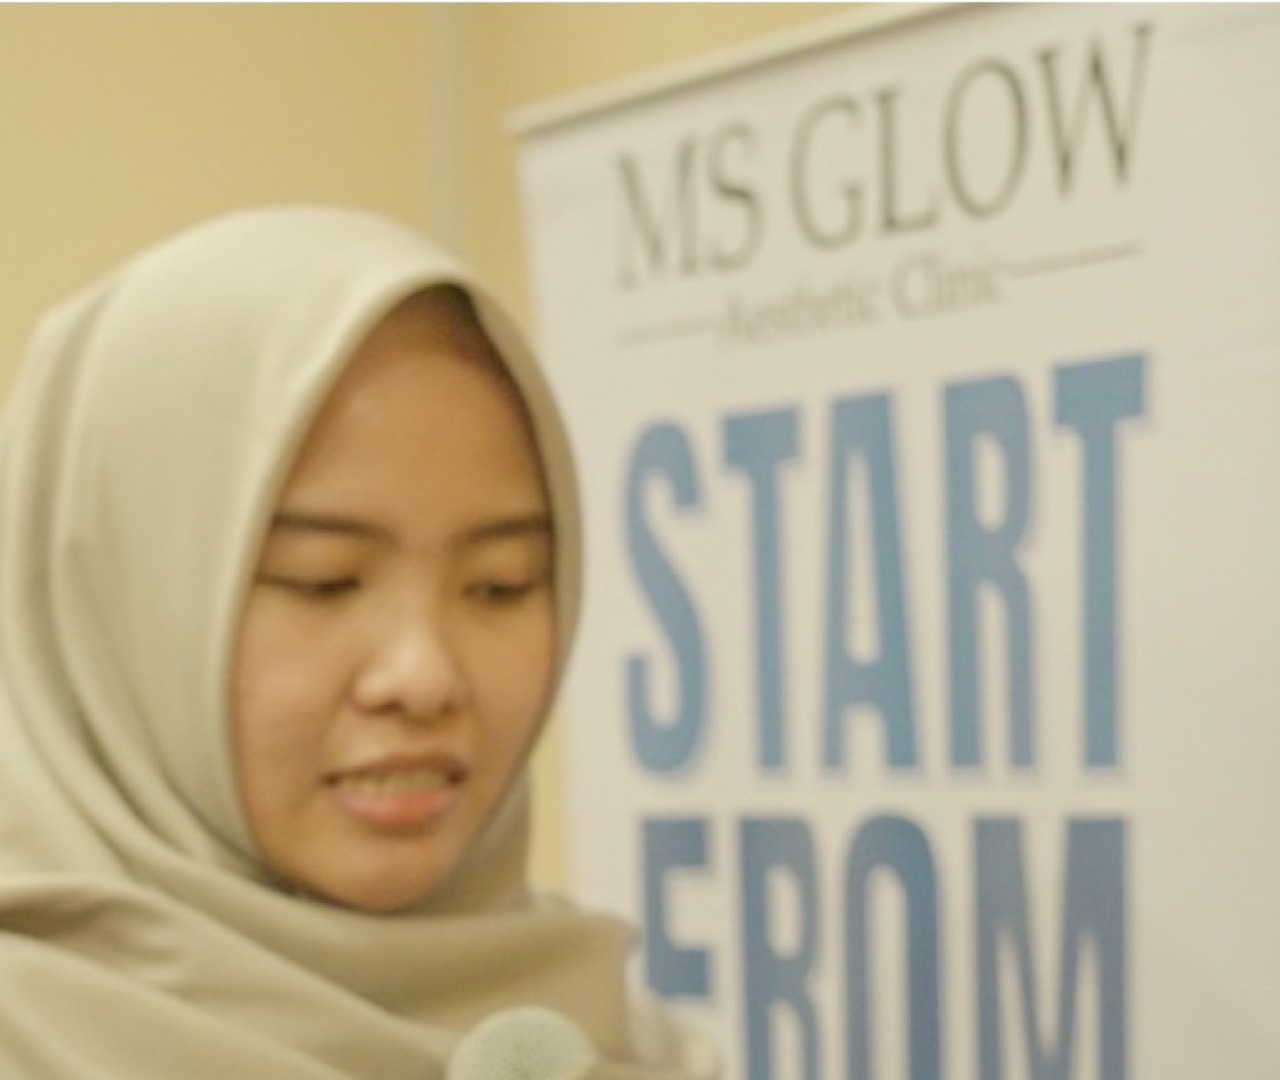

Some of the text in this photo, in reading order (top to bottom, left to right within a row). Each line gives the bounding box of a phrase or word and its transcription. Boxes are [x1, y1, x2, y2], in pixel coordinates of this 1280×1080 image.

[613, 21, 1154, 293] MS GLOW
[888, 249, 1006, 321] Clinic
[623, 350, 1150, 777] START
